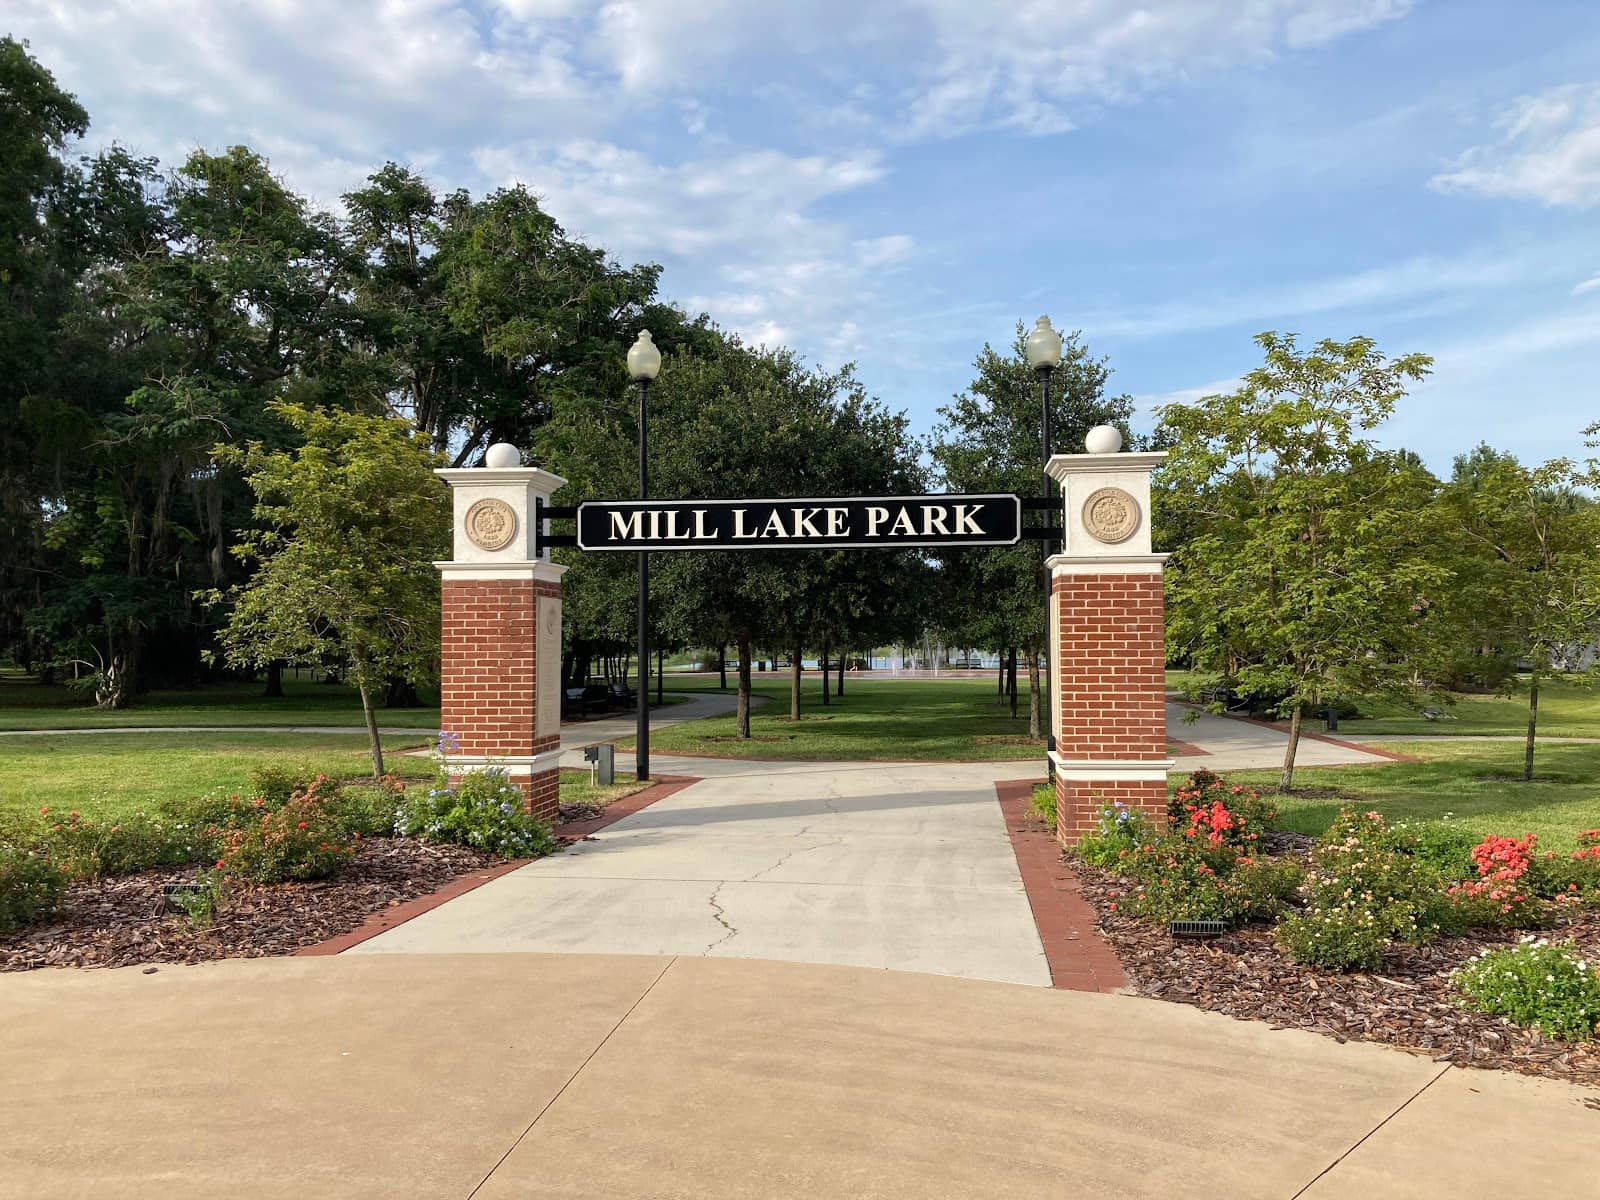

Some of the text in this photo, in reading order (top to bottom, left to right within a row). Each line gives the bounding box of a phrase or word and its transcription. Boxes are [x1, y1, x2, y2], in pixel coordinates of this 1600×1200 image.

[607, 504, 987, 540] MILL LAKE PARK
